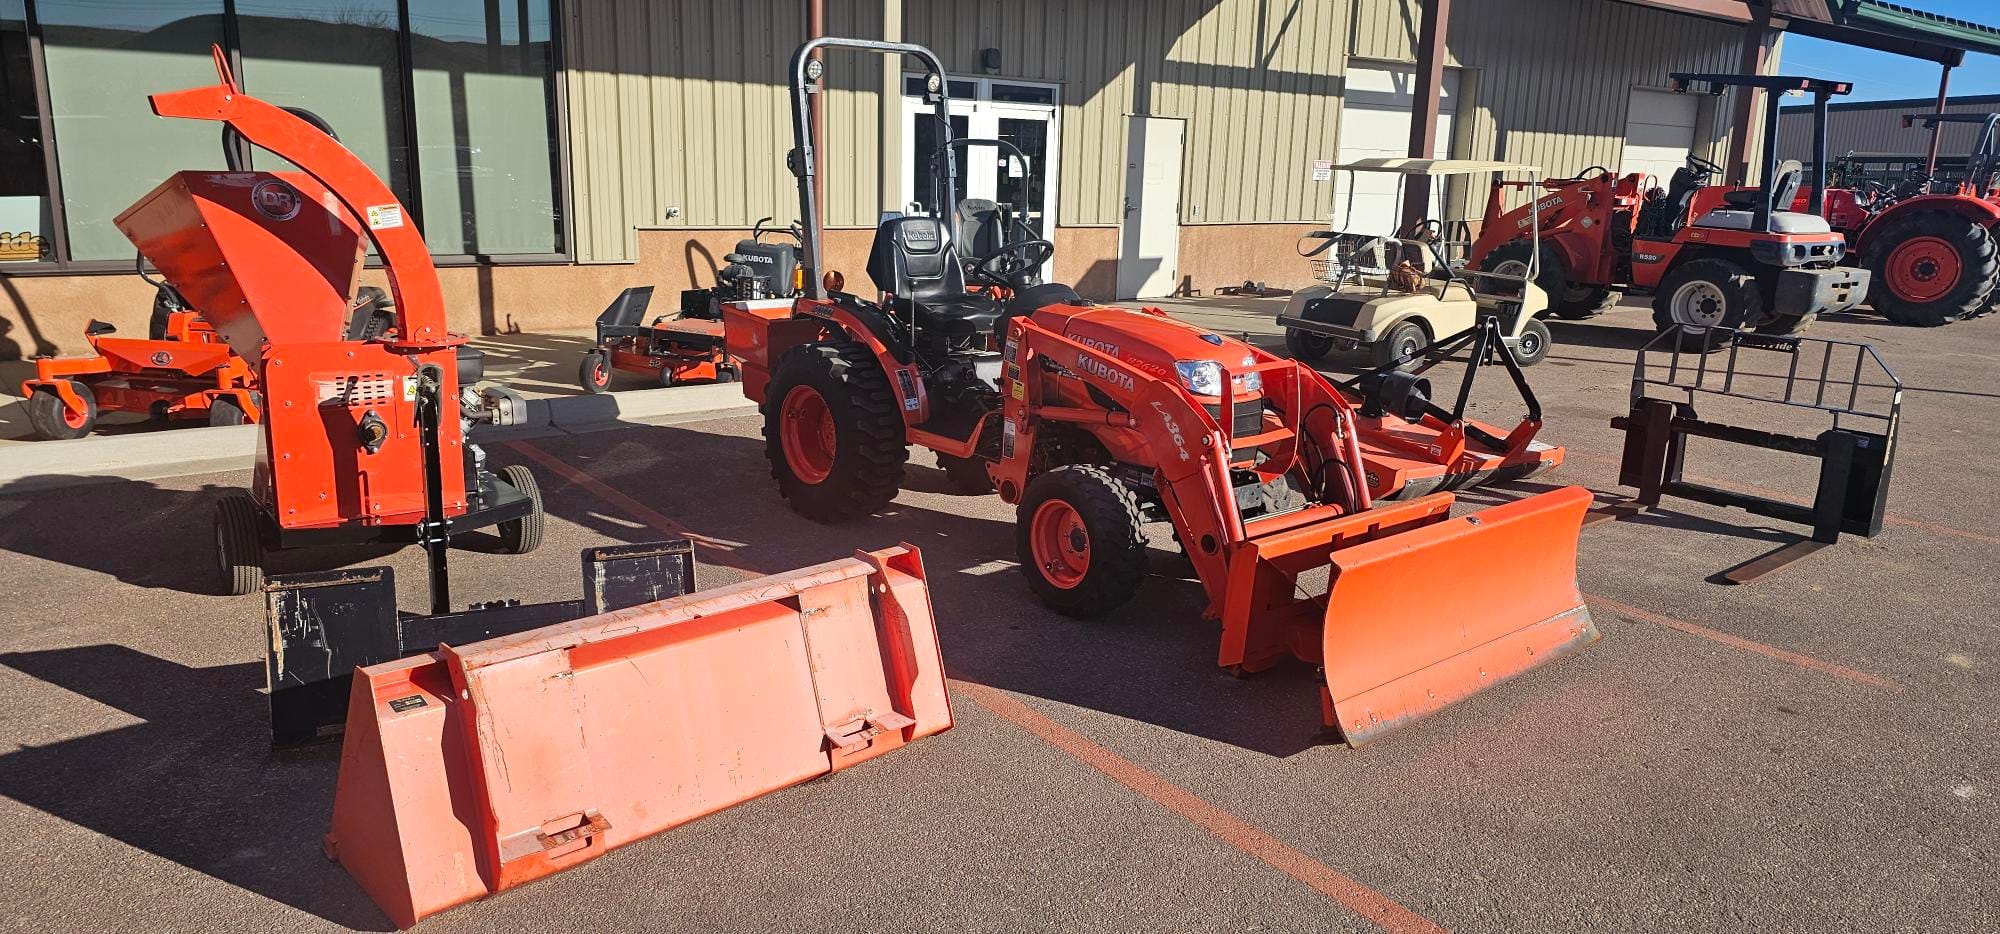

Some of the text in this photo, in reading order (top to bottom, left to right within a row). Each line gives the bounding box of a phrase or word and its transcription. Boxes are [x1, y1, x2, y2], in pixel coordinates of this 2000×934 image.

[262, 191, 293, 209] DR
[742, 254, 773, 265] KUBOTA
[1639, 253, 1657, 261] R520
[1077, 353, 1135, 393] KUBOTA
[1150, 401, 1190, 462] LA364
